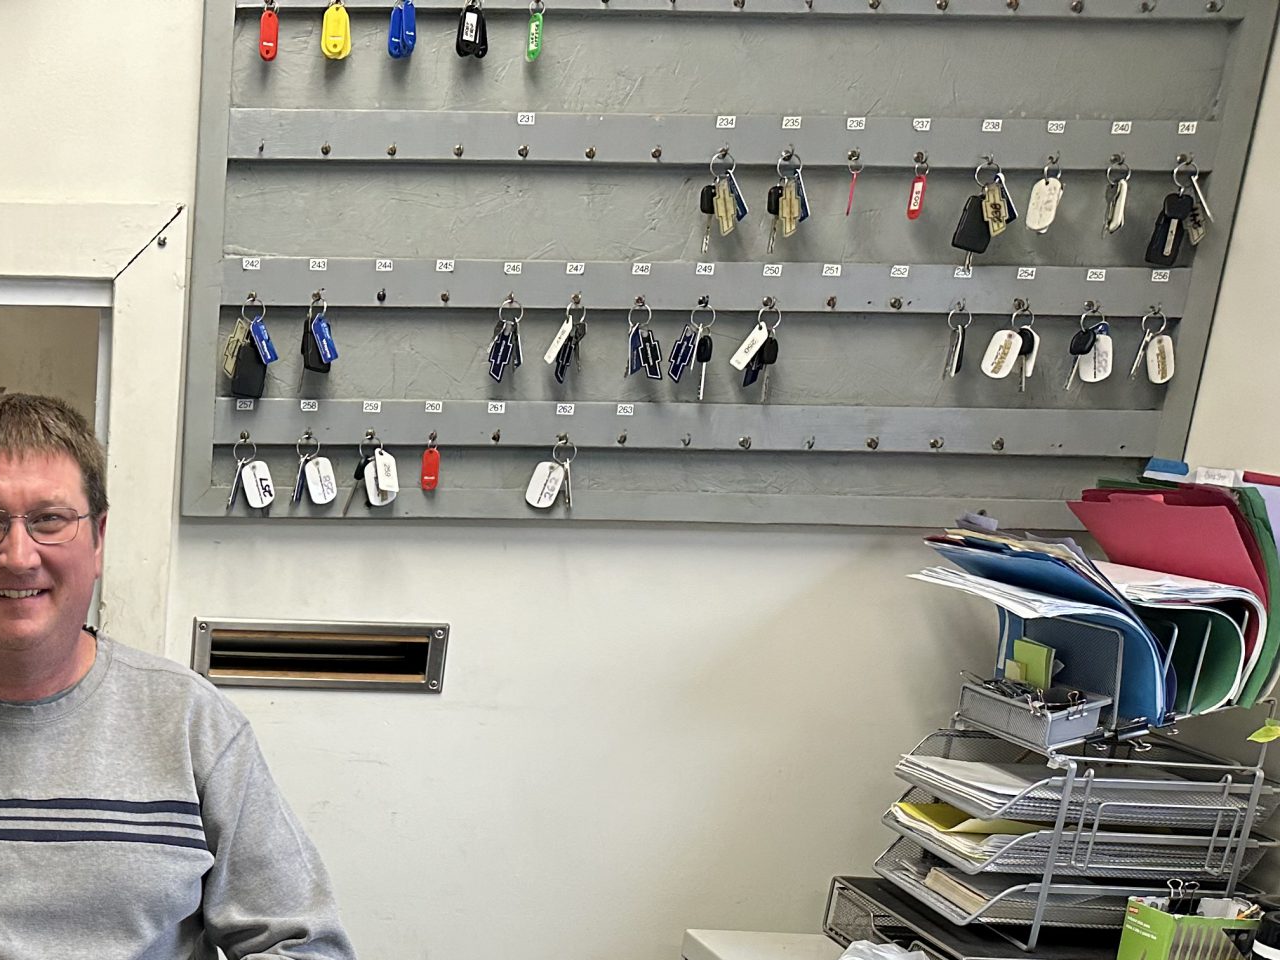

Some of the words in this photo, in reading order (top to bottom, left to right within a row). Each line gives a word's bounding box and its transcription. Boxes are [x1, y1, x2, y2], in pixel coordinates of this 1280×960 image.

[519, 114, 535, 124] 231
[718, 118, 734, 127] 234
[784, 119, 800, 128] 235
[848, 119, 864, 128] 236
[914, 120, 930, 129] 237
[984, 121, 1000, 130] 238
[1048, 123, 1064, 132] 239
[1113, 124, 1130, 133] 240
[1179, 123, 1195, 132] 241
[244, 259, 260, 268] 242
[310, 260, 326, 269] 243
[377, 261, 392, 270] 244
[437, 261, 453, 270] 245
[505, 264, 522, 273] 246
[568, 264, 584, 274] 247
[633, 264, 650, 274] 248
[696, 264, 713, 274] 249
[764, 266, 781, 275] 250
[824, 266, 839, 275] 251
[891, 267, 908, 276] 252
[1018, 269, 1034, 278] 254
[1088, 270, 1105, 280] 255
[1152, 271, 1169, 280] 256
[238, 400, 253, 409] 257
[301, 401, 317, 410] 258
[364, 402, 379, 411] 259
[426, 402, 441, 411] 260
[489, 404, 504, 412] 261
[557, 405, 573, 414] 262
[618, 405, 634, 414] 263
[258, 477, 273, 498] 257
[543, 476, 559, 500] 262
